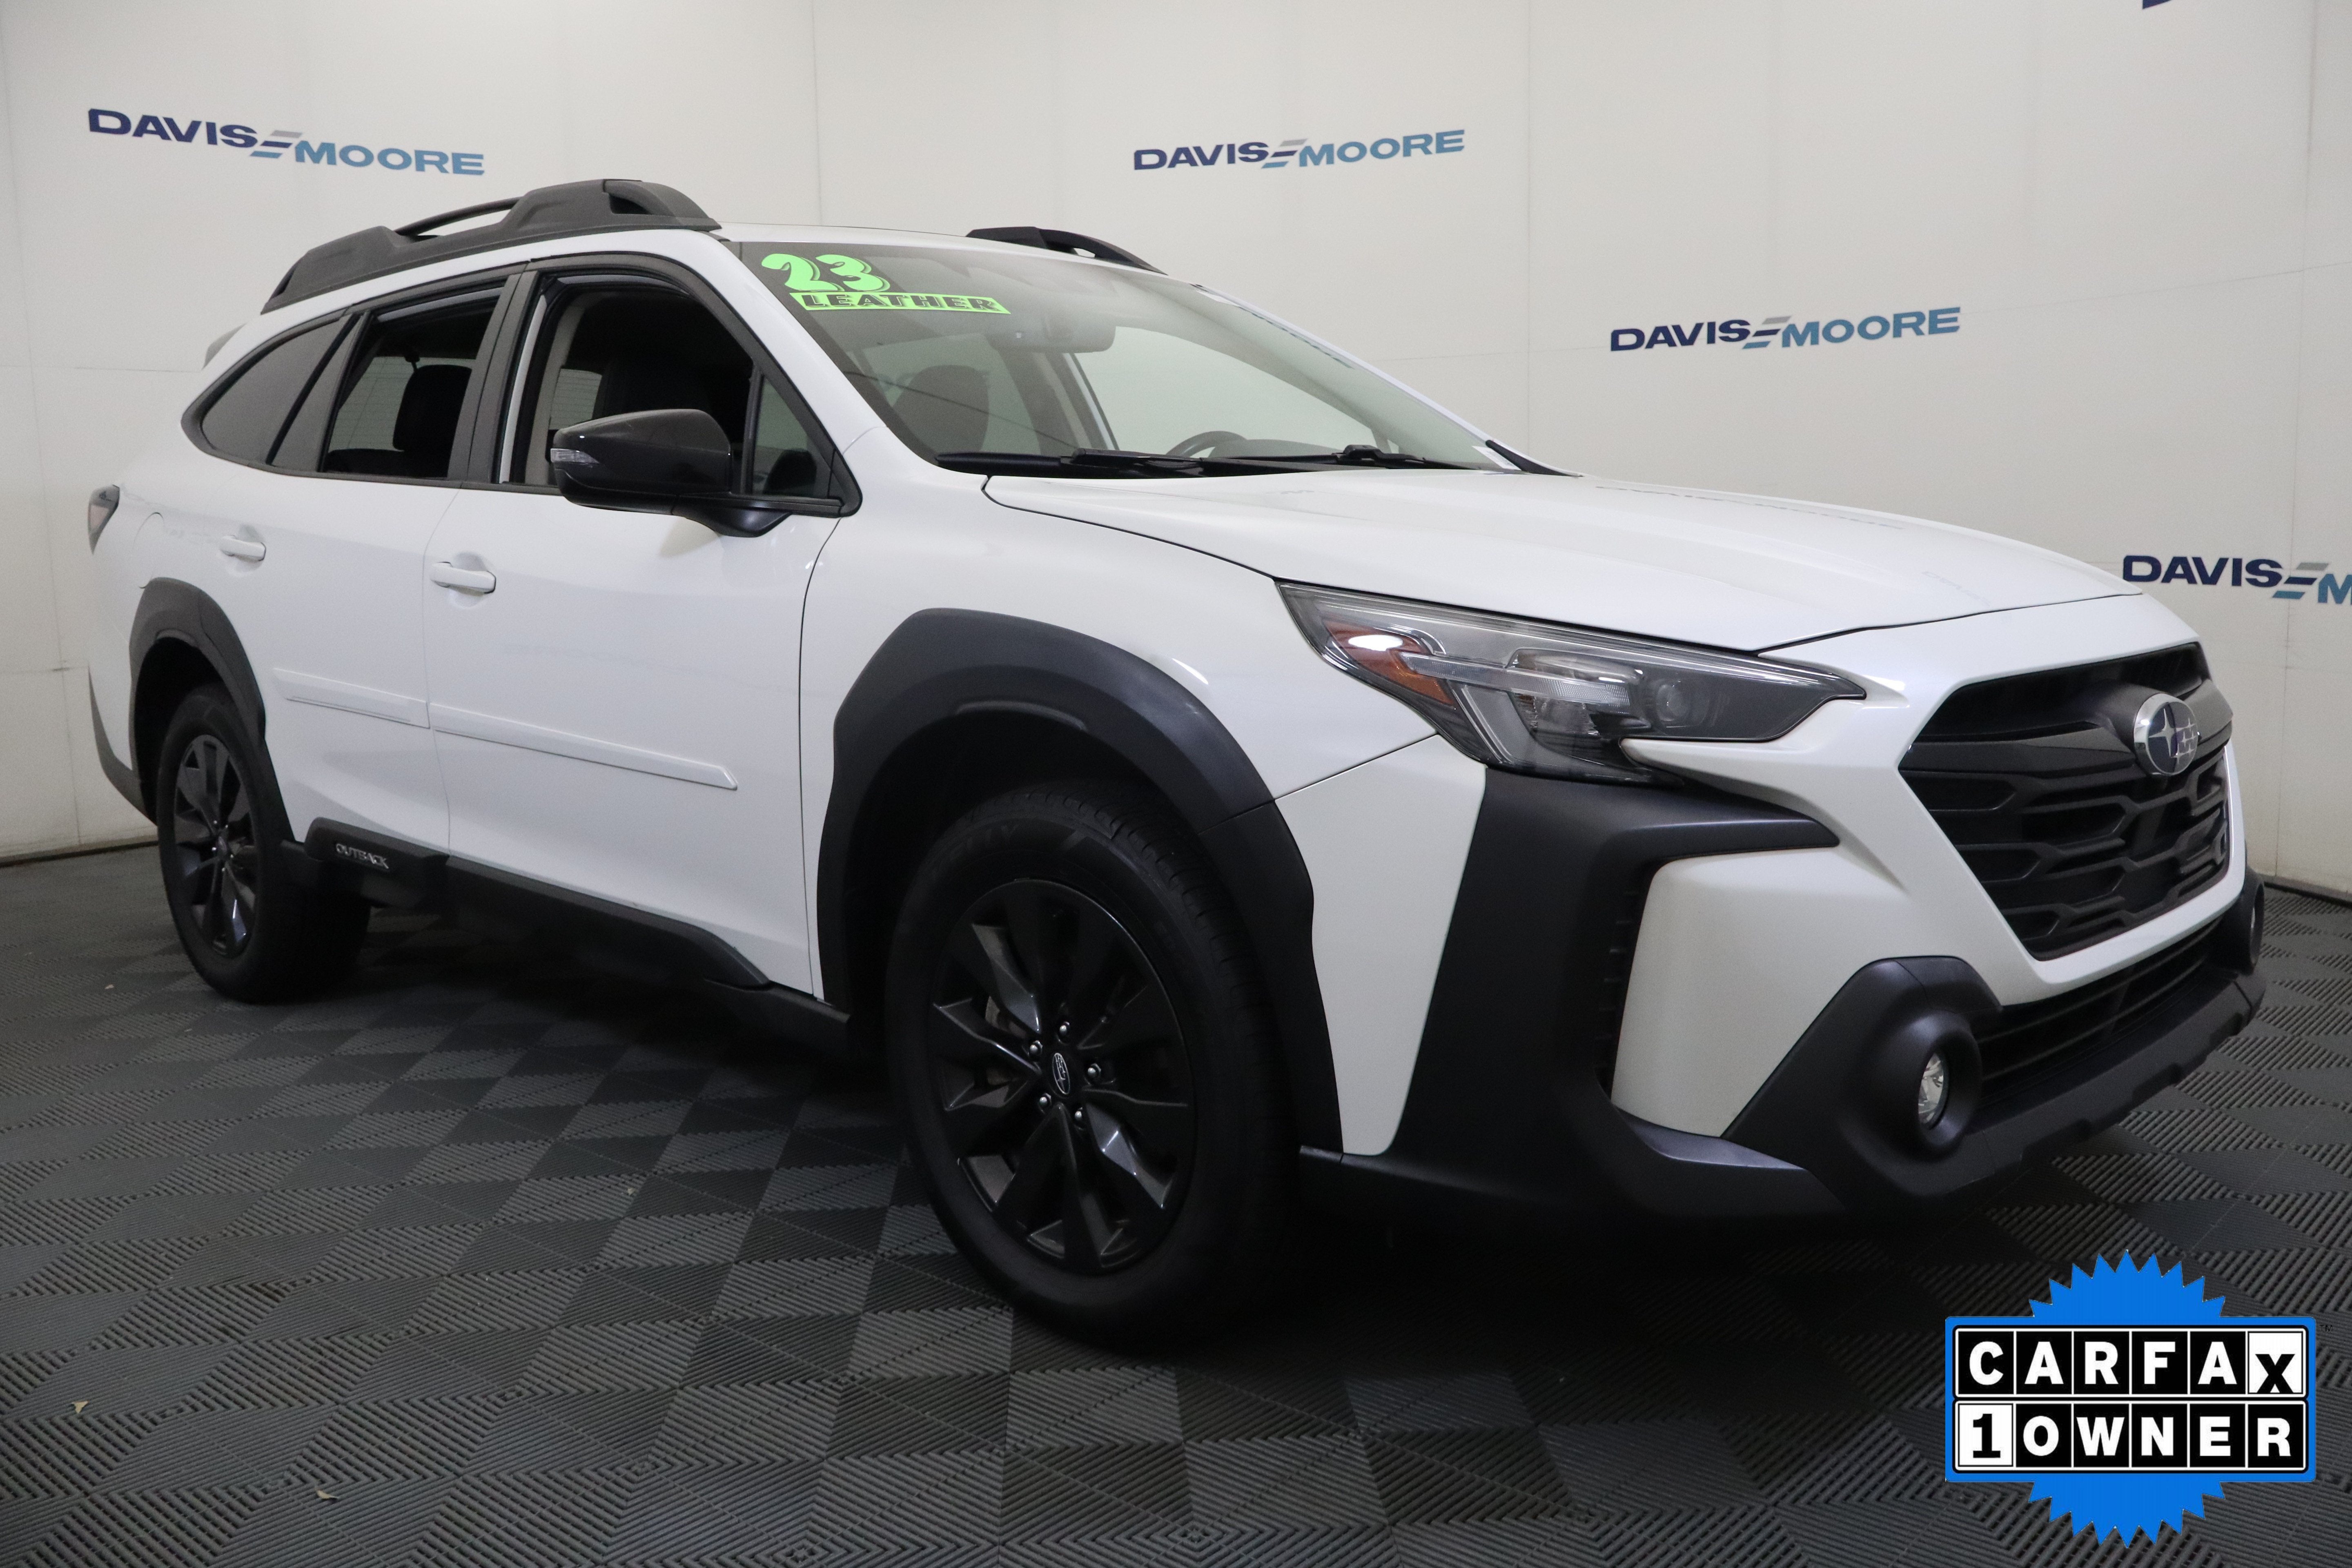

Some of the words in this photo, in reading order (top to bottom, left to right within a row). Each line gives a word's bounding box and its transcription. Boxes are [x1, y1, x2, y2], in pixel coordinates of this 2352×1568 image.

[88, 108, 258, 148] DAVIS
[294, 140, 485, 176] MOORE
[1134, 142, 1270, 171] DAVIS
[1299, 129, 1465, 167] MOORE
[761, 254, 891, 292] 23
[801, 294, 1001, 312] LEATHER
[1610, 319, 1751, 352] DAVIS
[1782, 307, 1960, 348] MOORE
[2123, 555, 2283, 588] DAVIS
[335, 843, 389, 869] OUTBACK
